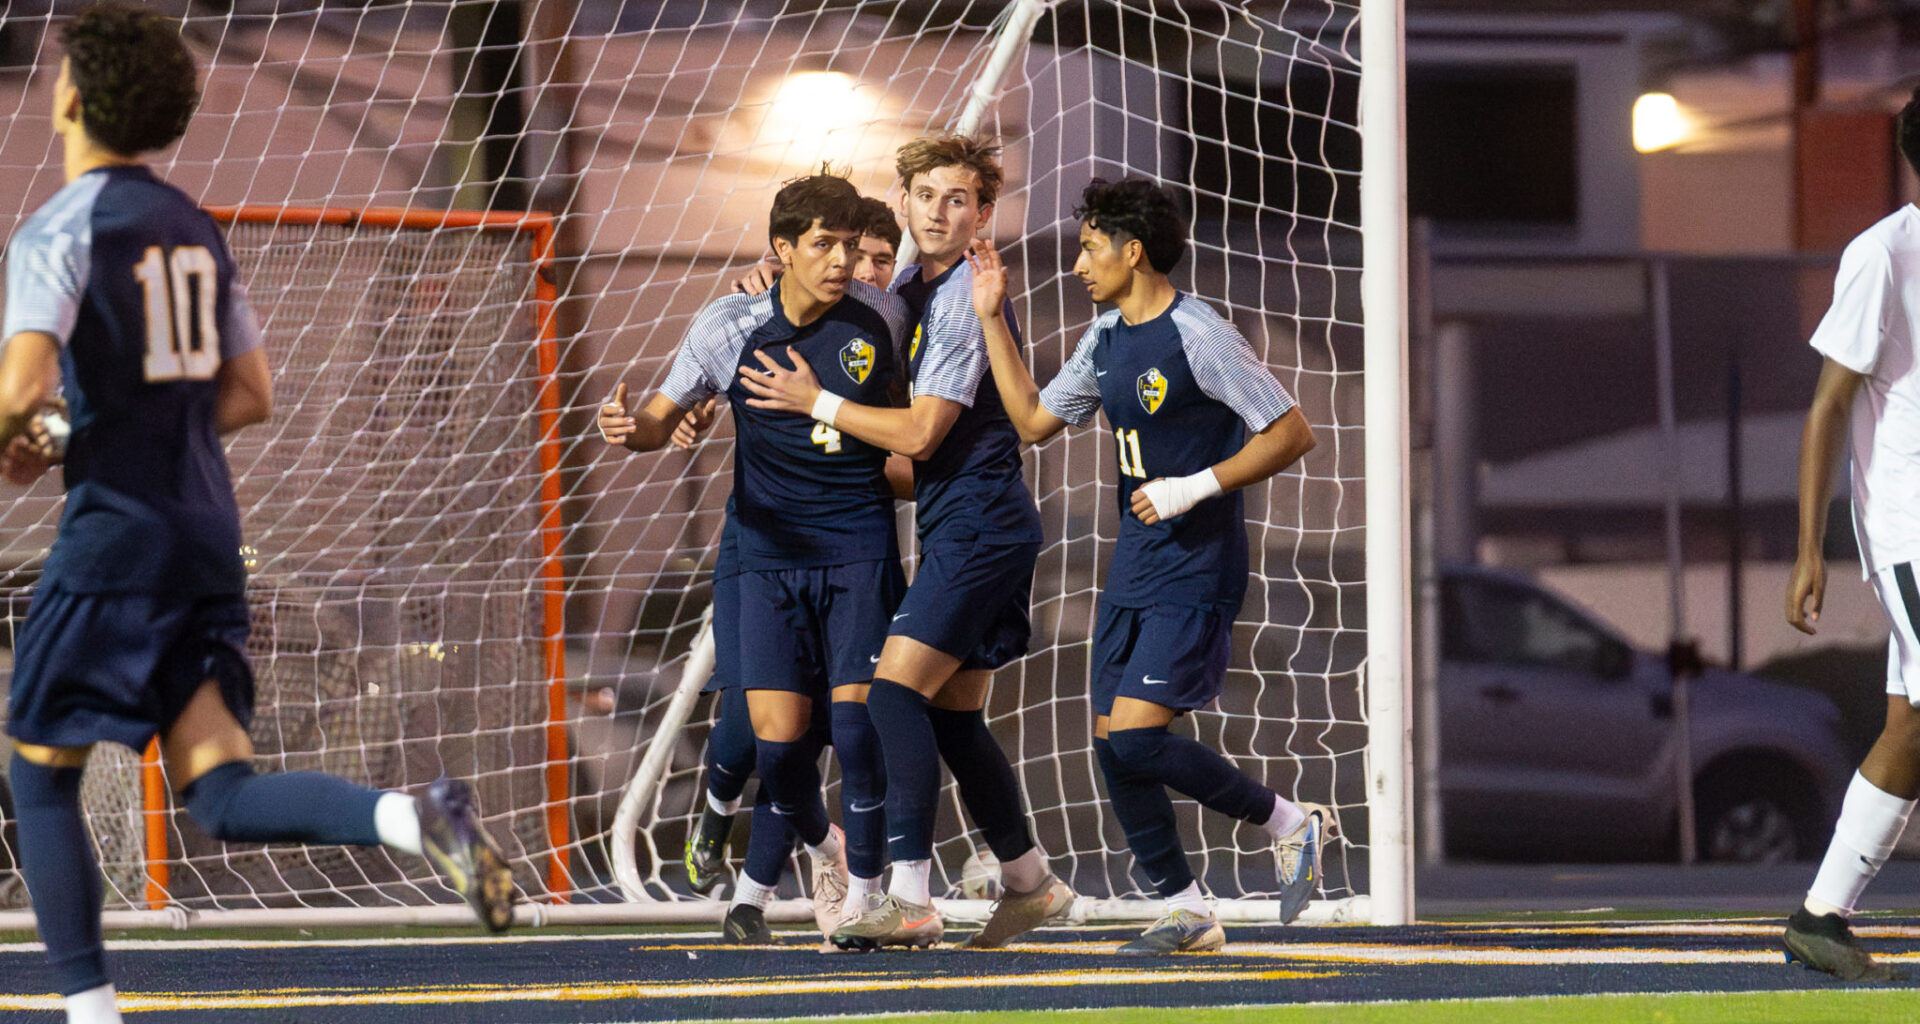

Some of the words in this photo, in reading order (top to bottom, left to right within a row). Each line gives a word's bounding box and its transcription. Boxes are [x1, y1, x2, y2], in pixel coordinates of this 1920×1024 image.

[132, 245, 221, 382] 10
[811, 421, 842, 453] 4
[1115, 427, 1147, 478] 11
